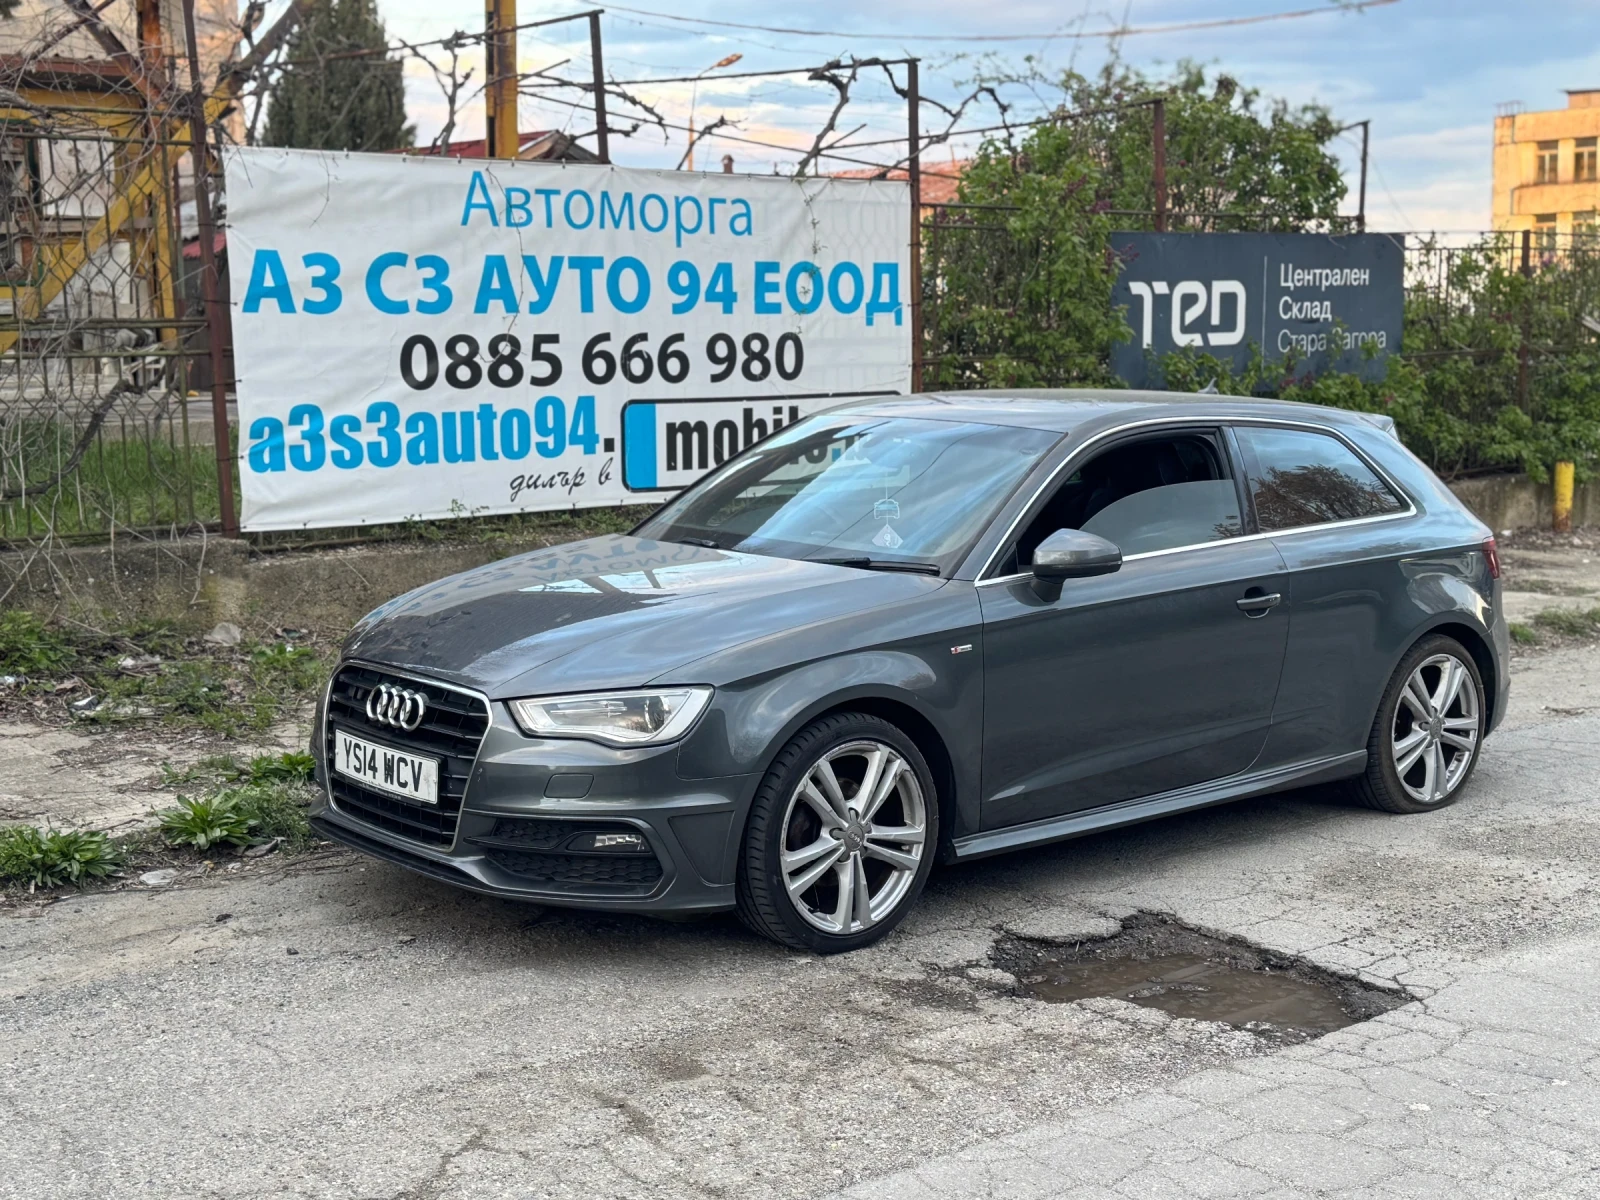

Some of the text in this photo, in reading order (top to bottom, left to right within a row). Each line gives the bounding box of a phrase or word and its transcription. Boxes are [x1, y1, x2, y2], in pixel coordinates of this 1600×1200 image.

[461, 170, 753, 248] Автоморга
[473, 254, 652, 317] АУТО
[666, 260, 739, 317] 94
[753, 260, 904, 326] ЕООД
[1279, 263, 1370, 292] Централен
[1278, 295, 1333, 323] Склад
[400, 331, 804, 390] 0885 666 980
[1277, 328, 1328, 358] Стара
[343, 737, 379, 780] YS14
[383, 751, 424, 793] WCV
